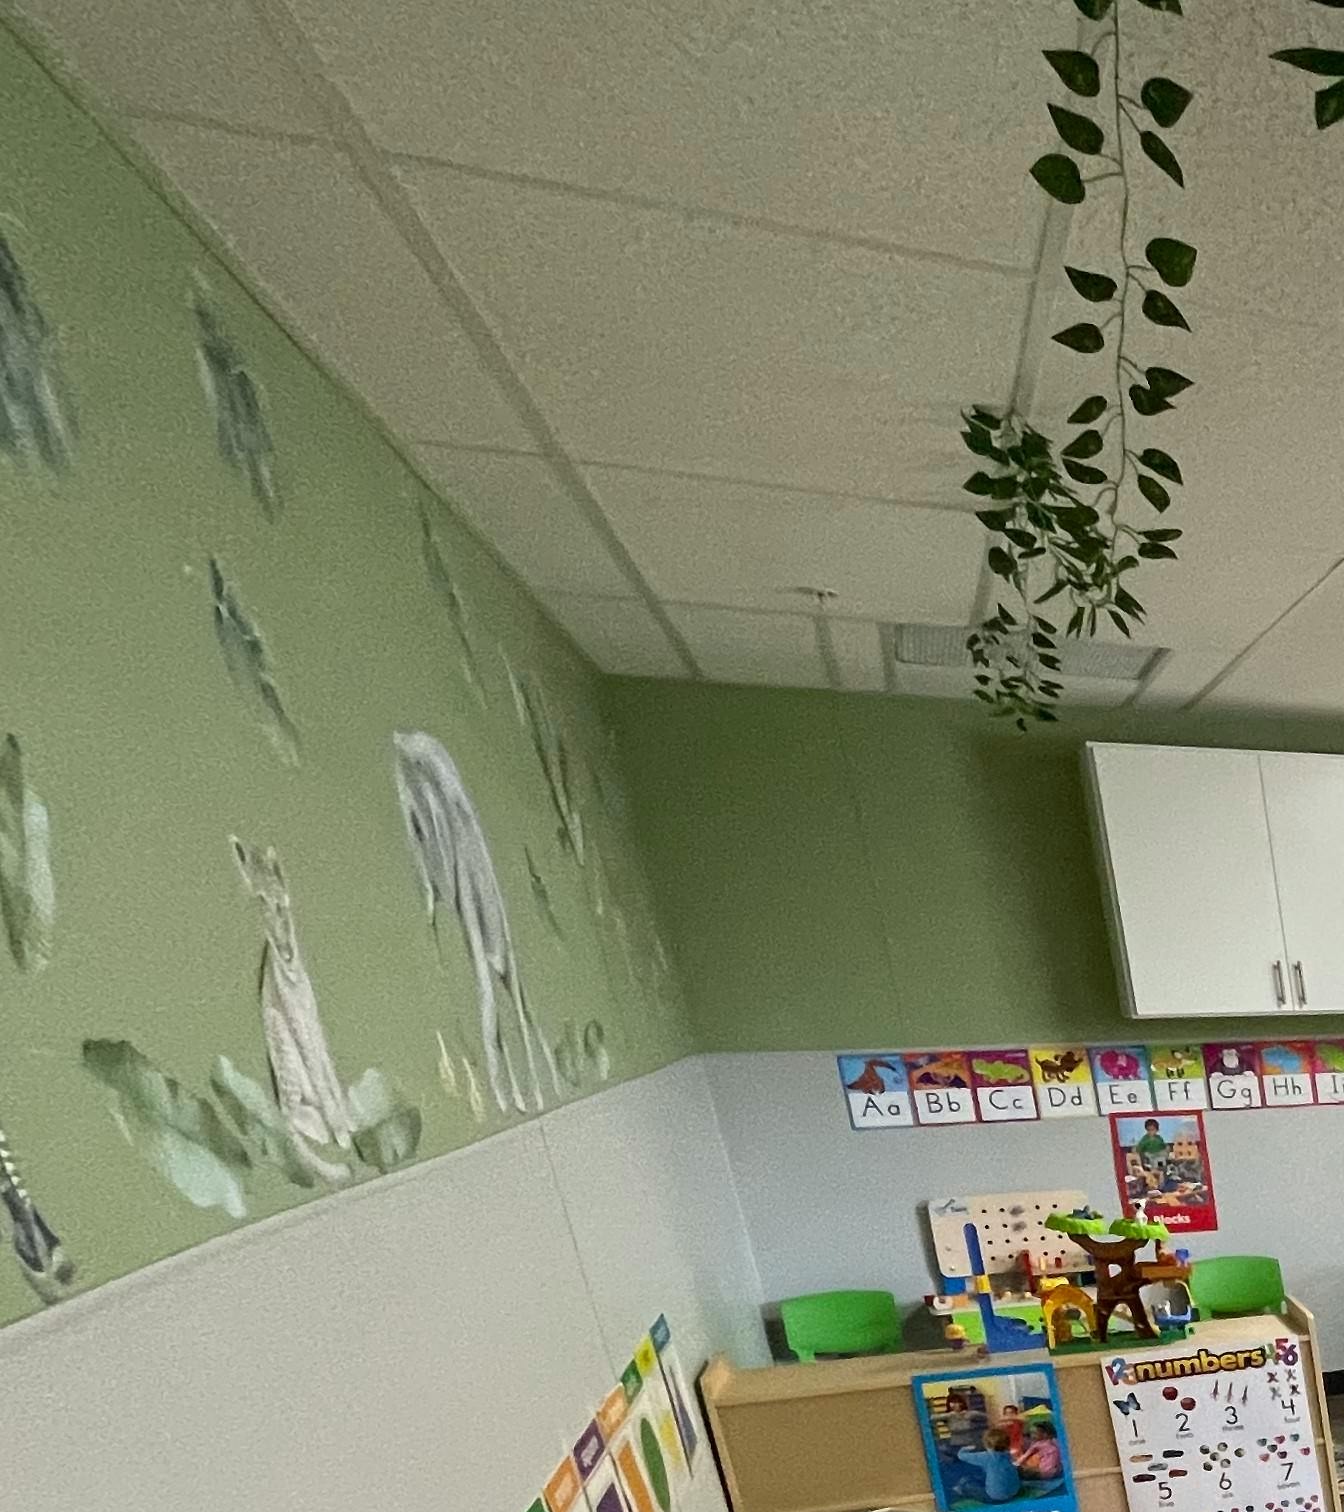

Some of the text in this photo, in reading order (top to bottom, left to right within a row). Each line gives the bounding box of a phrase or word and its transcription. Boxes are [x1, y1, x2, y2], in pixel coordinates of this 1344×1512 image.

[862, 1096, 901, 1117] Aa
[925, 1091, 961, 1114] Bb
[988, 1089, 1025, 1110] Cc
[1047, 1086, 1083, 1107] Dd
[1109, 1084, 1138, 1105] Ee
[1167, 1081, 1191, 1102] Ff
[1216, 1079, 1253, 1107] Gg
[1272, 1077, 1303, 1096] Hh
[1134, 1349, 1266, 1382] numbers
[1224, 1405, 1239, 1425] 3
[1280, 1398, 1296, 1416] 4
[1131, 1418, 1139, 1438] 1
[1174, 1412, 1191, 1433] 2
[1219, 1471, 1233, 1491] 6
[1280, 1462, 1294, 1481] 7
[1158, 1481, 1173, 1501] 5
